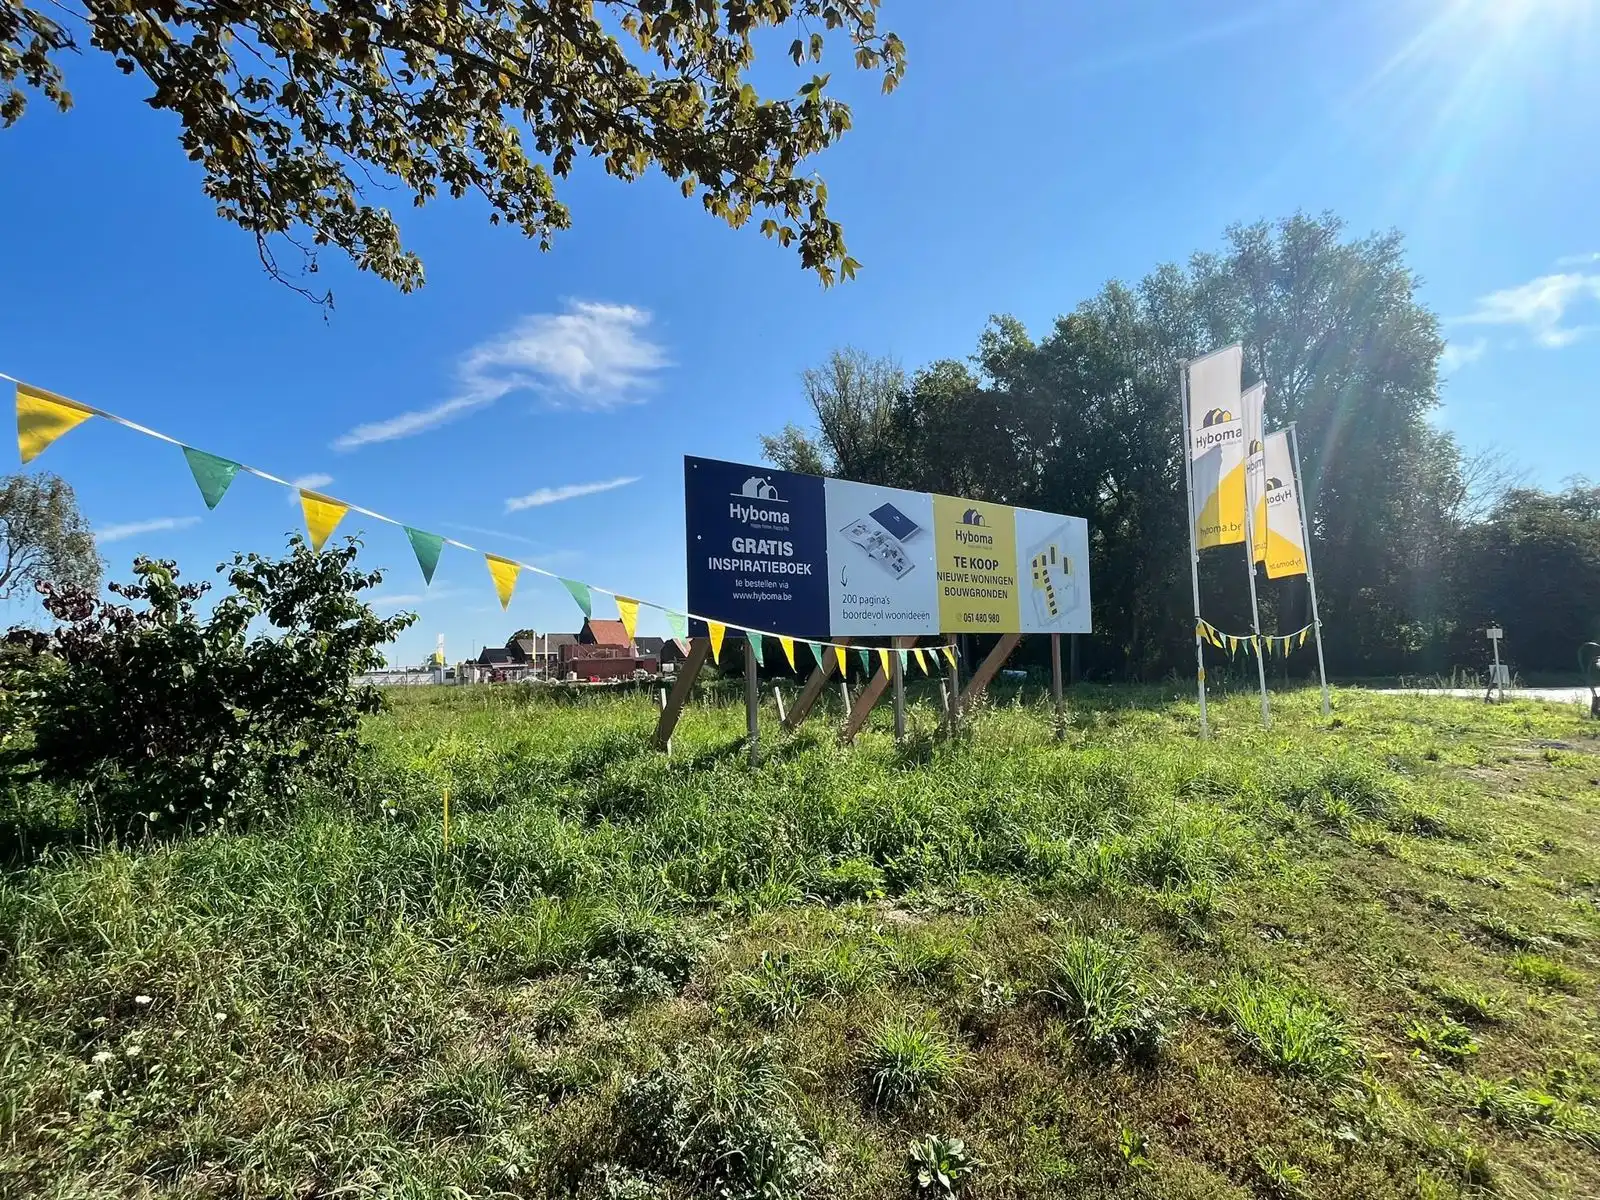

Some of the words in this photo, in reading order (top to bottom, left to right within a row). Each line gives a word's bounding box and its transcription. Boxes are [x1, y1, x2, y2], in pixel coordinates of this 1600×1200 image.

[1196, 428, 1242, 449] Hyboma
[729, 503, 790, 524] Hyboma
[955, 529, 993, 544] Hyboma
[731, 537, 794, 557] GRATIS
[708, 557, 812, 575] INSPIRATIEBOEK
[953, 555, 968, 569] TE
[969, 556, 999, 571] KOOP
[735, 578, 743, 587] te
[744, 578, 777, 589] bestellen
[778, 580, 789, 589] via
[936, 571, 970, 583] NIEUWE
[971, 573, 1014, 586] WONINGEN
[732, 591, 792, 602] www.hyboma.be
[944, 586, 1008, 599] BOUWGRONDEN
[842, 594, 857, 604] 200
[859, 594, 891, 607] pagina's
[842, 608, 884, 620] boordevol
[963, 613, 974, 623] 051
[975, 613, 987, 623] 480
[988, 613, 1000, 624] 980
